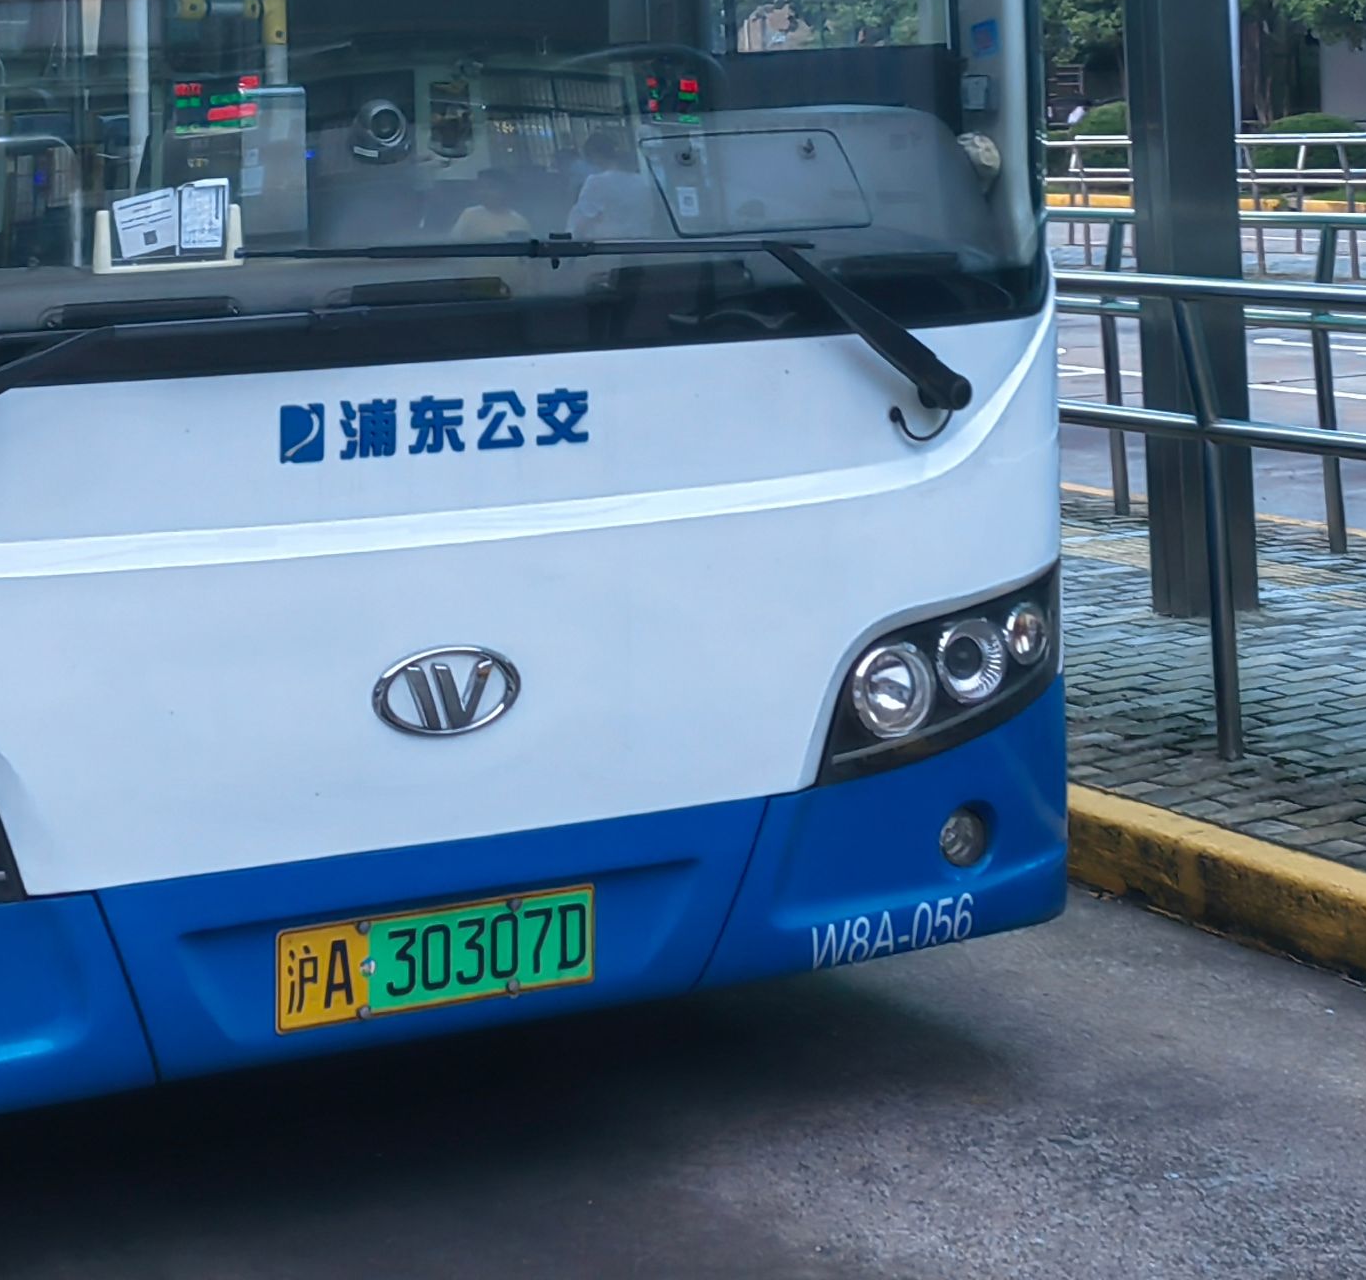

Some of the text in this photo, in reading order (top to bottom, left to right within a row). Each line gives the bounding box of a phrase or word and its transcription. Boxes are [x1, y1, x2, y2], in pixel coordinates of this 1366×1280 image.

[339, 387, 590, 461] 浦东公交
[287, 902, 586, 1015] 沪A 30307D
[811, 892, 975, 970] W8A-056
